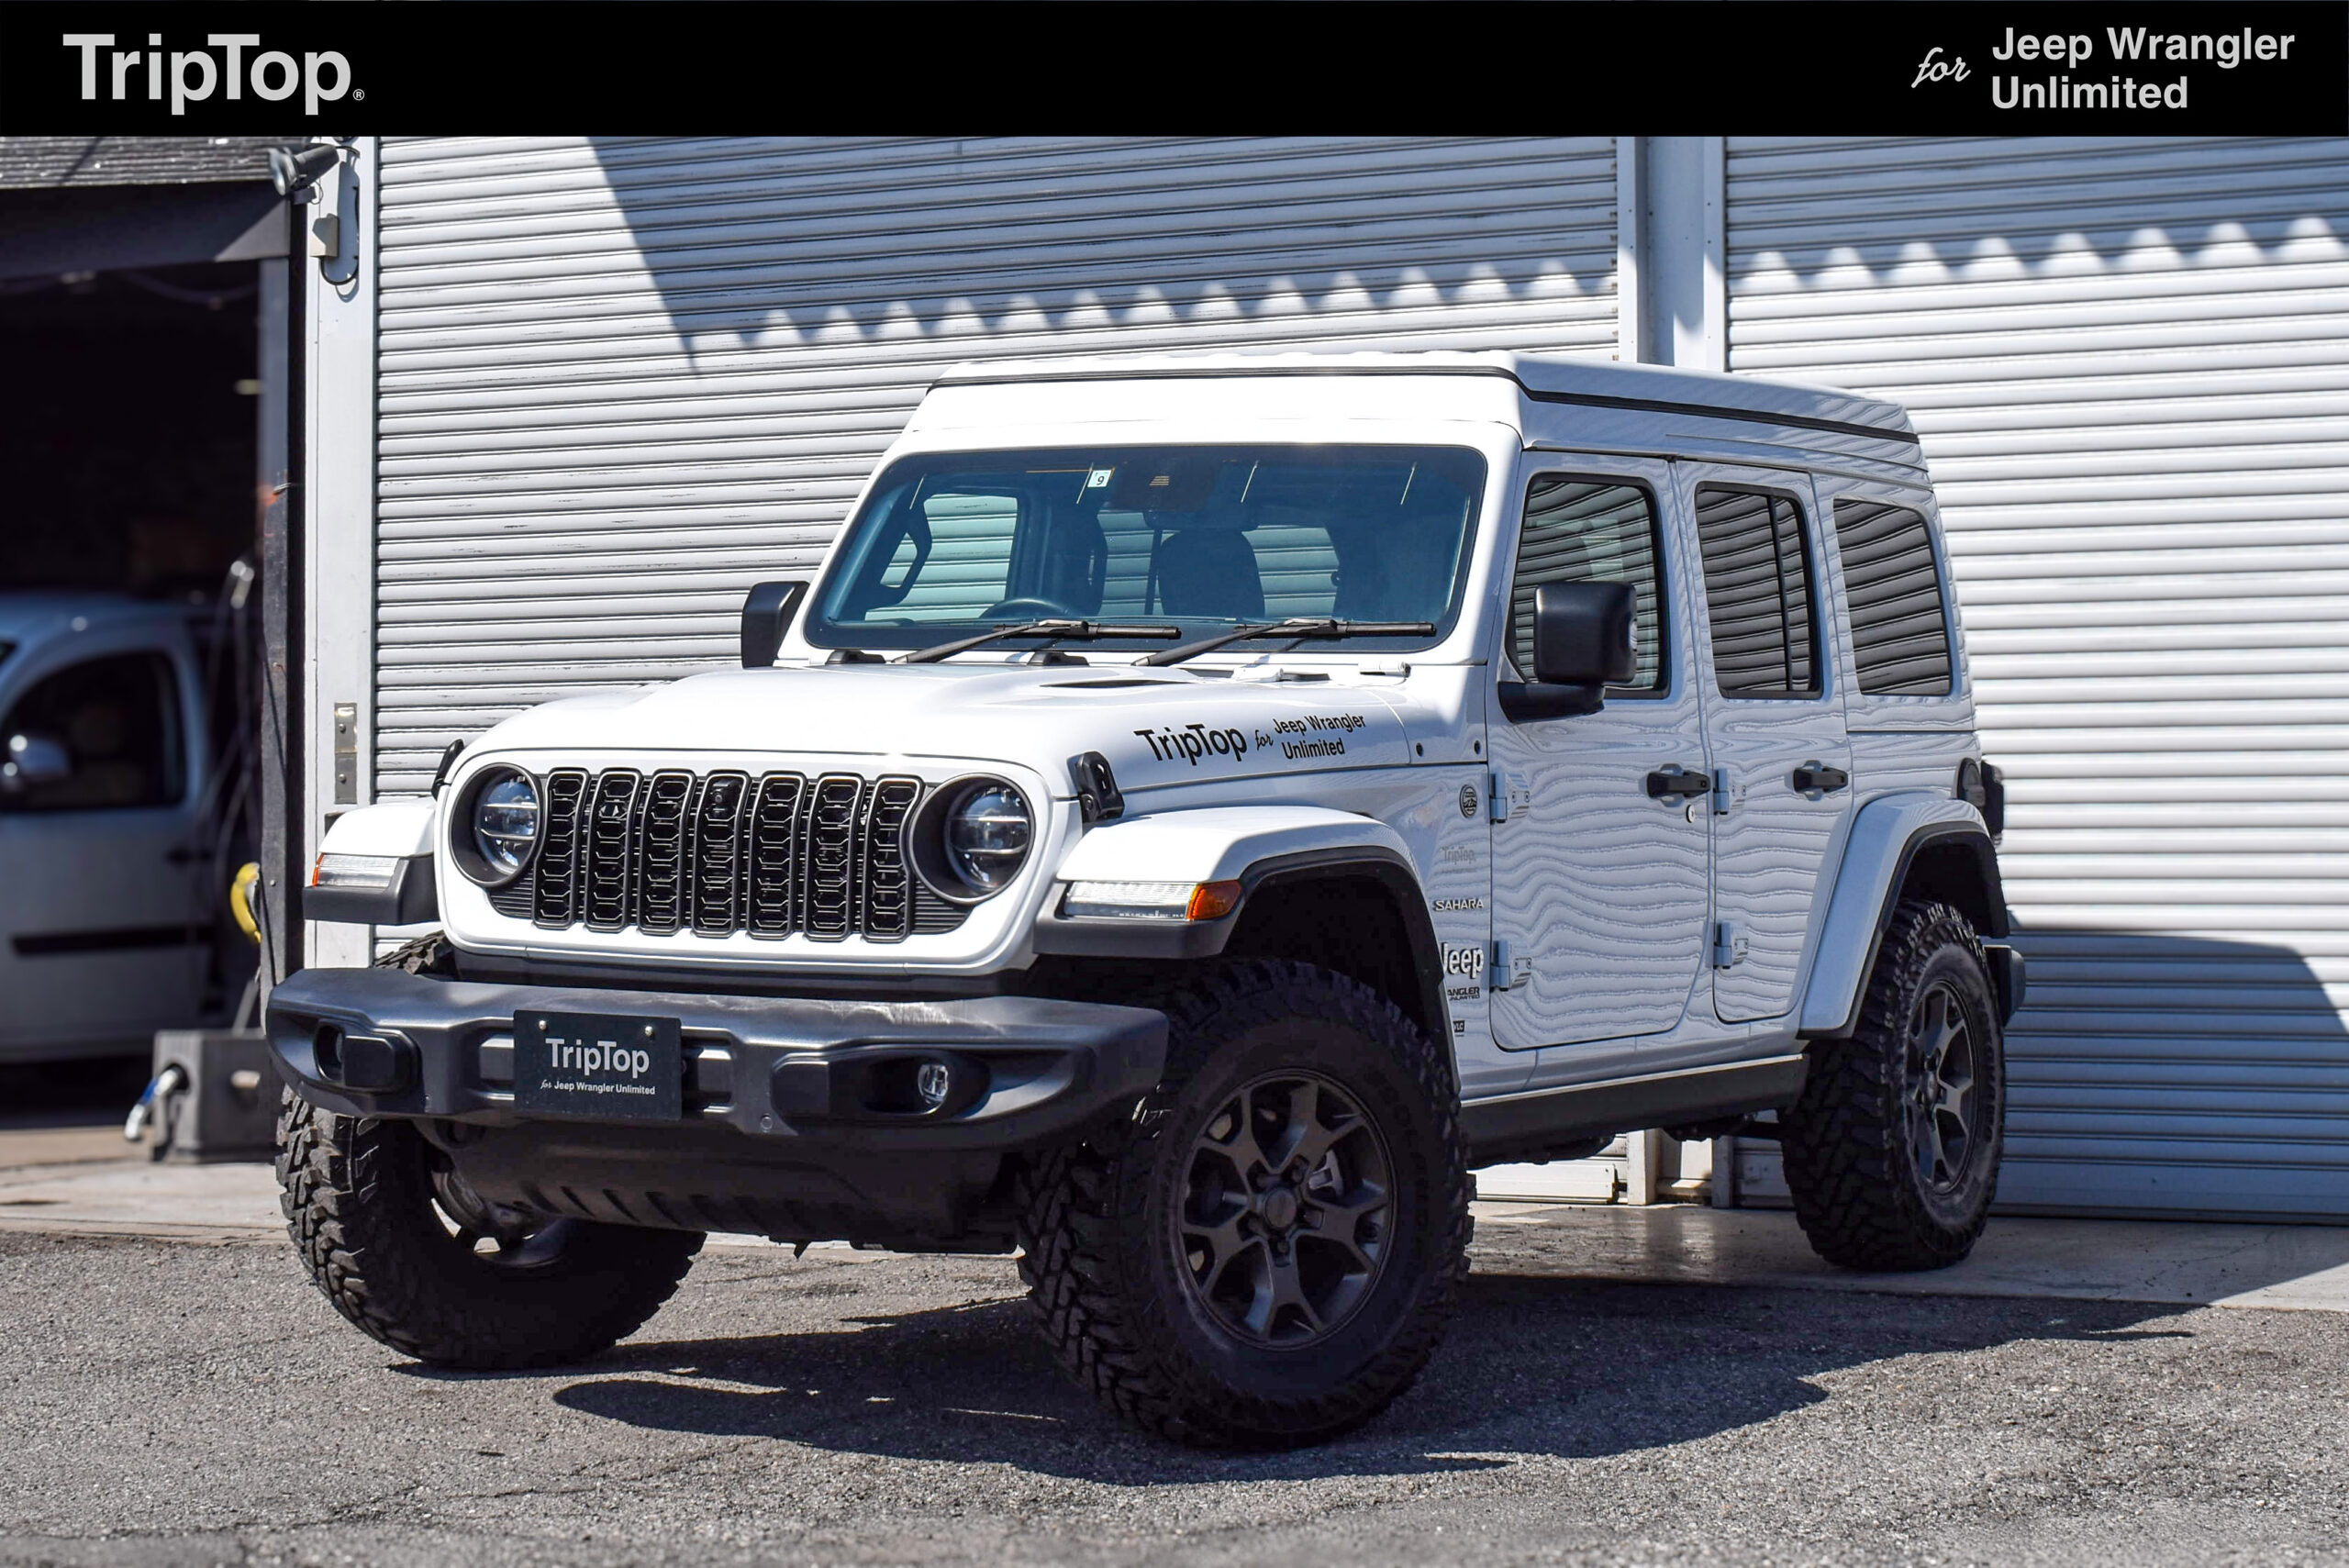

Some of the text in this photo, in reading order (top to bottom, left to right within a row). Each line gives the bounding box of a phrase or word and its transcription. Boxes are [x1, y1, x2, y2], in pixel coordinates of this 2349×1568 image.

[1097, 475, 1105, 486] 9
[1273, 713, 1367, 736] Jeep Wrangler
[1133, 723, 1248, 766] TripTop
[1254, 728, 1275, 751] for
[1281, 737, 1346, 761] Unlimited
[1433, 898, 1485, 912] SAHARA
[1447, 986, 1480, 996] ANGLER
[545, 1038, 650, 1079] TripTop
[554, 1080, 575, 1092] Jeep
[576, 1082, 615, 1094] Wrangler
[616, 1084, 656, 1095] Unlimited
